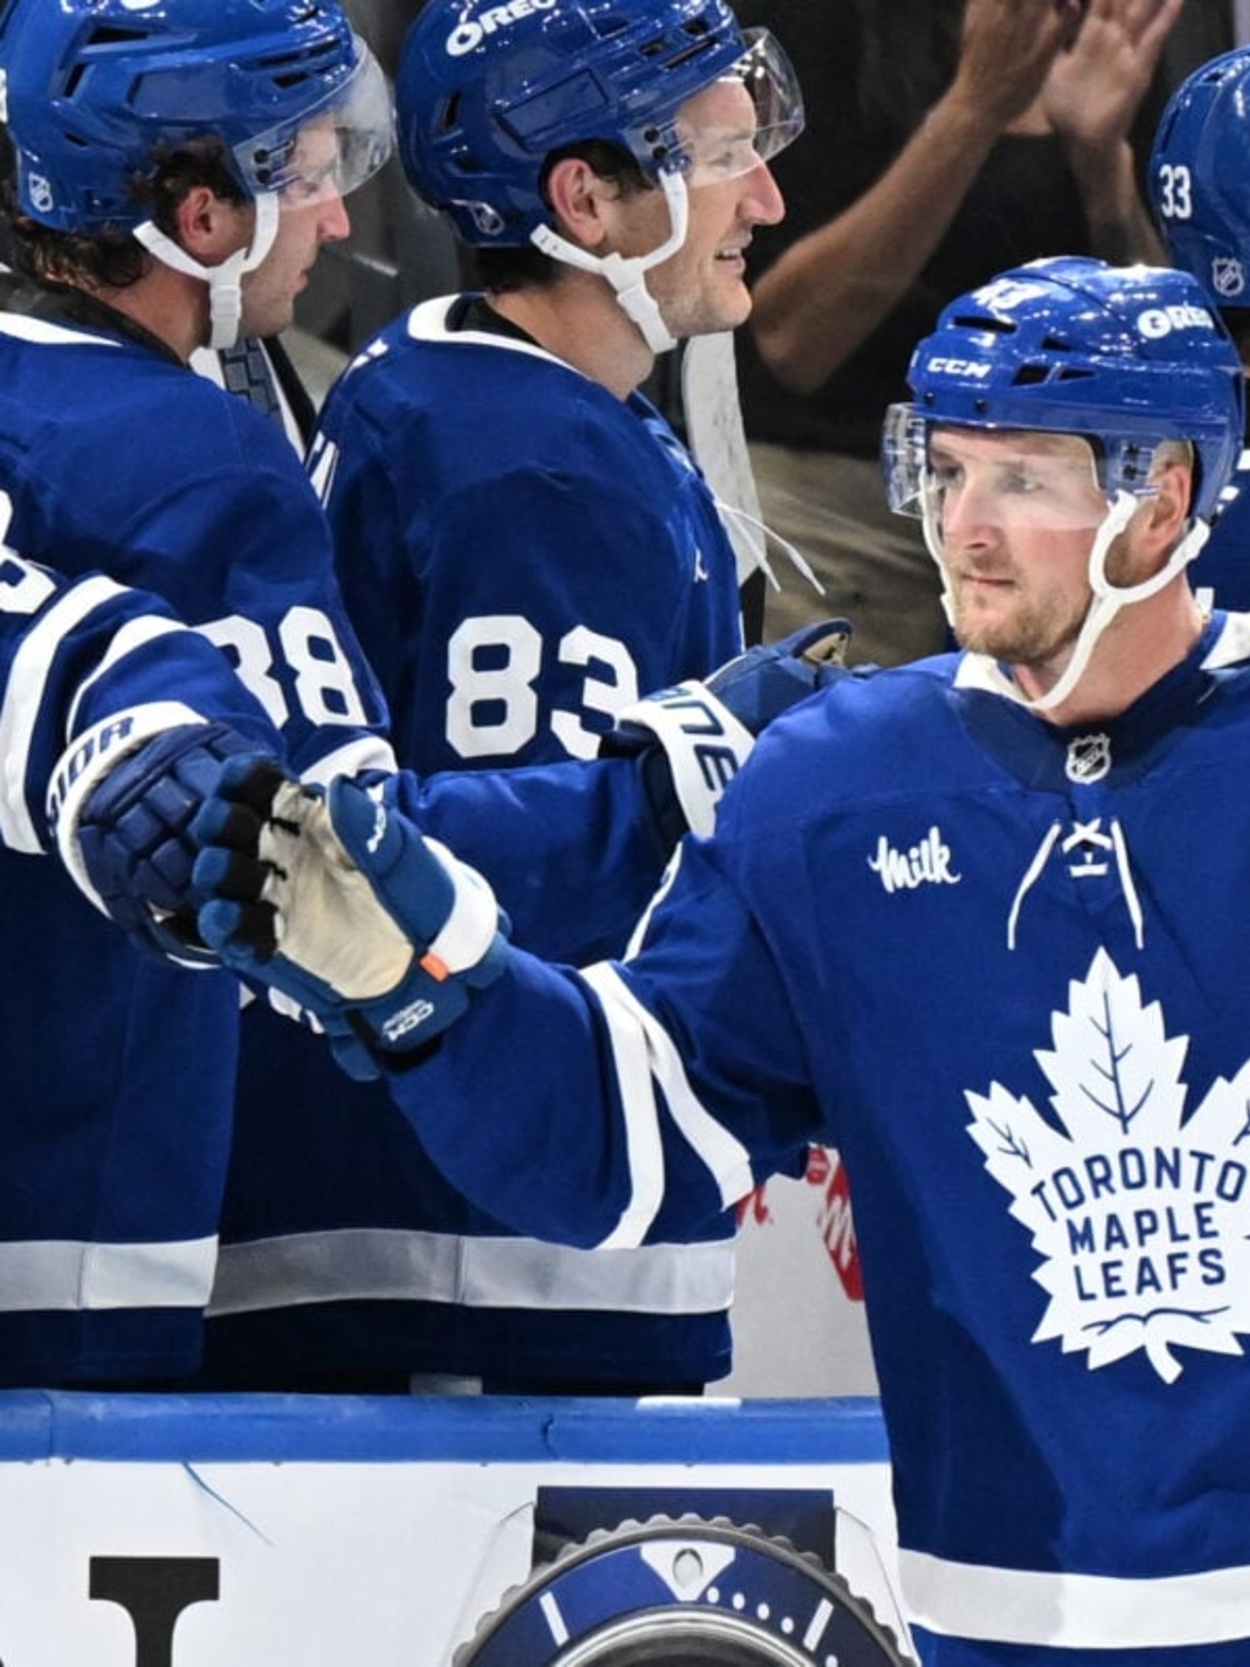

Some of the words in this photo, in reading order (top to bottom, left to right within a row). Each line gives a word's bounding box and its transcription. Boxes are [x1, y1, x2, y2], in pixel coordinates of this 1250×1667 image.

[1159, 164, 1192, 219] 33
[1137, 305, 1215, 339] ORE
[927, 357, 993, 378] CCM
[446, 614, 639, 761] 83
[866, 826, 962, 893] Milk
[1031, 1147, 1247, 1222] TORONTO
[1066, 1201, 1219, 1256] MAPLE
[1074, 1248, 1226, 1301] LEAFS
